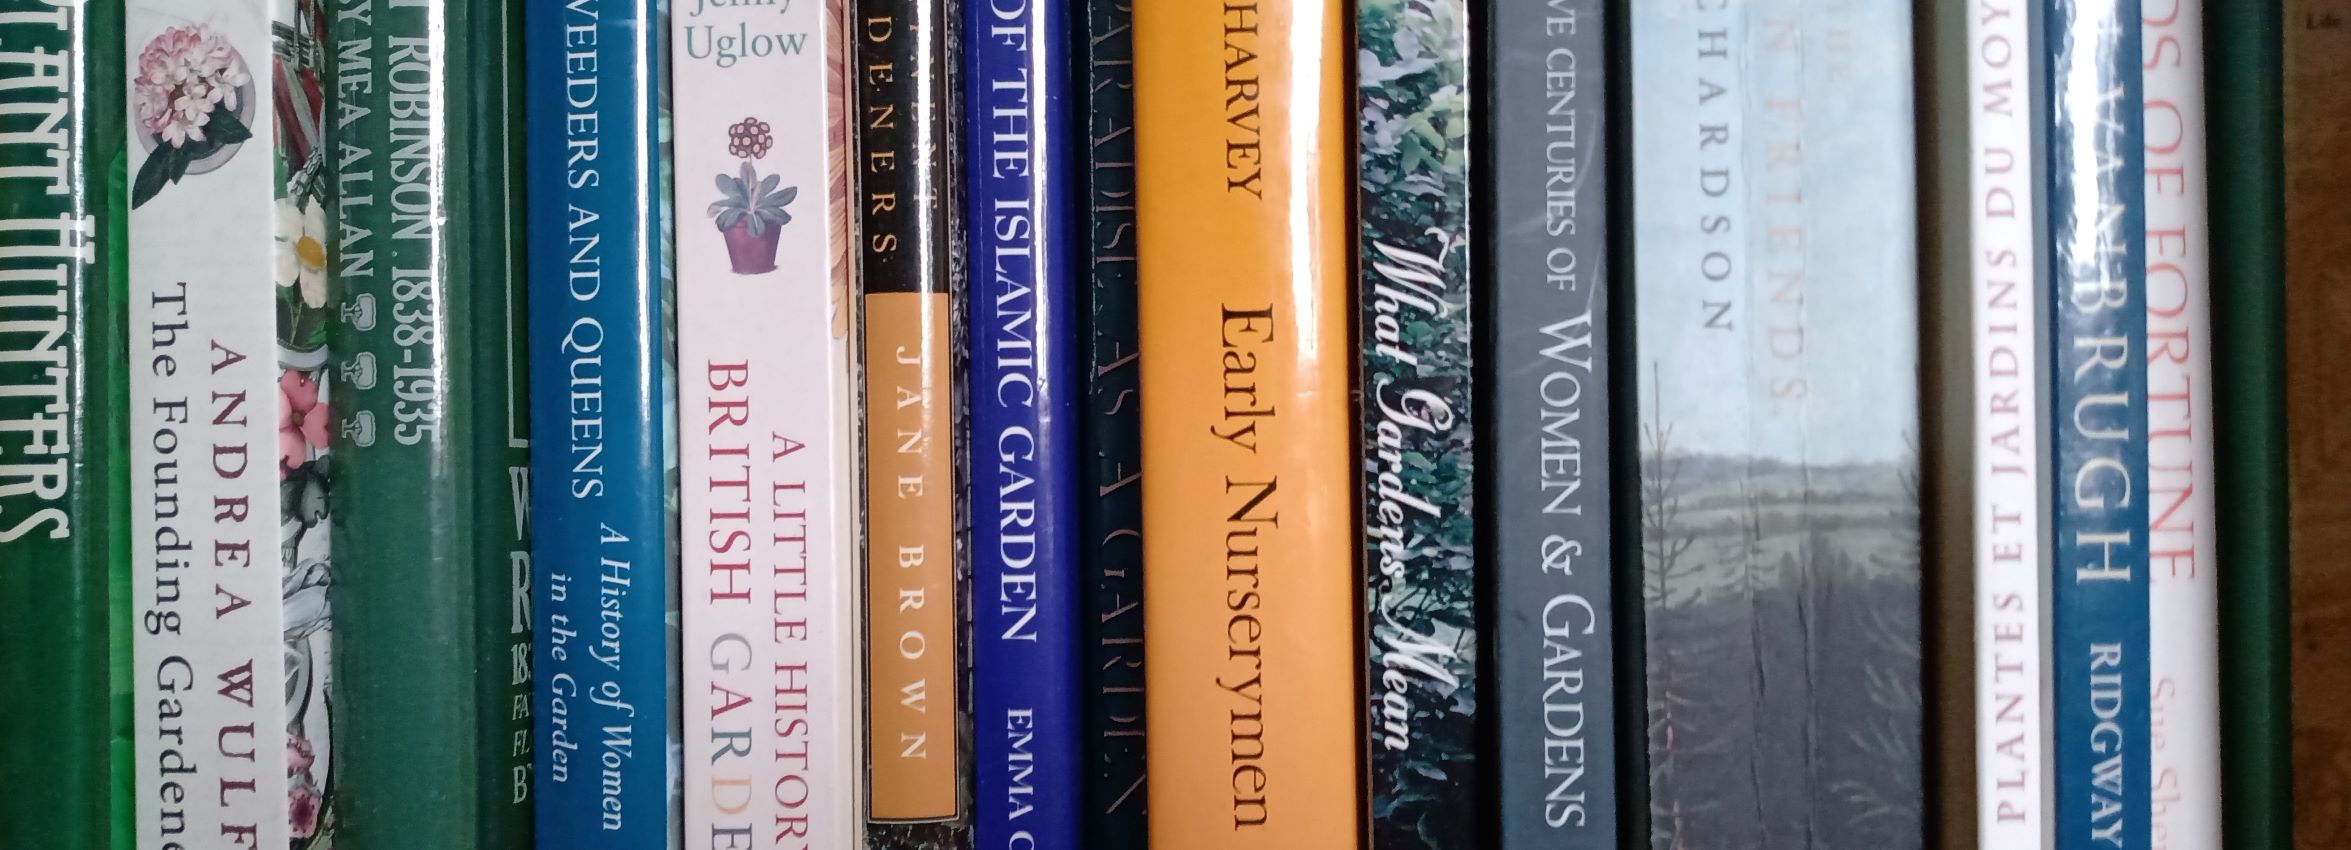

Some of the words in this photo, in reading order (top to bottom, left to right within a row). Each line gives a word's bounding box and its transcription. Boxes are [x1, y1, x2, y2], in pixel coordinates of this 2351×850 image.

[0, 0, 74, 195] LANT
[338, 0, 371, 25] Y
[338, 38, 372, 130] MEA
[684, 21, 808, 68] Uglow
[990, 0, 1028, 52] OF
[1981, 0, 2014, 118] MOY
[388, 35, 434, 240] ROBINSON
[866, 15, 897, 254] DENERS
[992, 67, 1029, 179] THE
[1093, 0, 1136, 287] ARADISE
[1224, 1, 1262, 200] HARVEY
[1546, 48, 1577, 236] CENTURIES
[1984, 147, 2016, 219] DU
[2142, 98, 2185, 196] OF
[338, 141, 374, 277] ALLAN
[568, 203, 601, 302] AND
[1546, 246, 1577, 292] OF
[1767, 97, 1807, 400] FRIENDS
[0, 212, 95, 541] HUNTERS
[152, 282, 189, 377] The
[392, 267, 440, 445] 1838-1935
[994, 198, 1034, 408] ISLAMIC
[1097, 332, 1139, 415] AS
[1210, 303, 1275, 453] Early
[1373, 227, 1450, 368] What
[1985, 248, 2027, 475] JARDINS
[2071, 85, 2131, 585] VANBRUGH
[211, 339, 252, 620] ANDREA
[562, 316, 604, 499] QUEENS
[708, 359, 752, 605] BRITISH
[771, 431, 806, 463] A
[896, 345, 924, 499] JANE
[1376, 378, 1454, 580] Gardens
[1539, 312, 1592, 516] WOMEN
[2144, 224, 2196, 582] FORTUNE
[144, 396, 193, 635] Founding
[551, 571, 571, 602] in
[600, 522, 629, 545] A
[773, 480, 808, 644] LITTLE
[998, 425, 1037, 643] GARDEN
[1541, 534, 1582, 576] &
[1991, 504, 2022, 564] ET
[551, 612, 577, 662] the
[589, 557, 631, 671] History
[590, 679, 634, 717] of
[899, 544, 927, 760] BROWN
[1100, 527, 1146, 816] GARDEN
[1216, 474, 1279, 832] Nurserymen
[1381, 588, 1459, 750] Mean
[217, 658, 258, 850] WULF
[551, 672, 578, 783] Garden
[602, 721, 632, 831] Women
[709, 632, 753, 850] GARDE
[774, 661, 809, 850] HISTOR
[1007, 707, 1034, 821] EMMA
[1542, 594, 1595, 828] GARDENS
[1993, 591, 2026, 824] PLANTES
[2089, 641, 2124, 850] RIDGWAY
